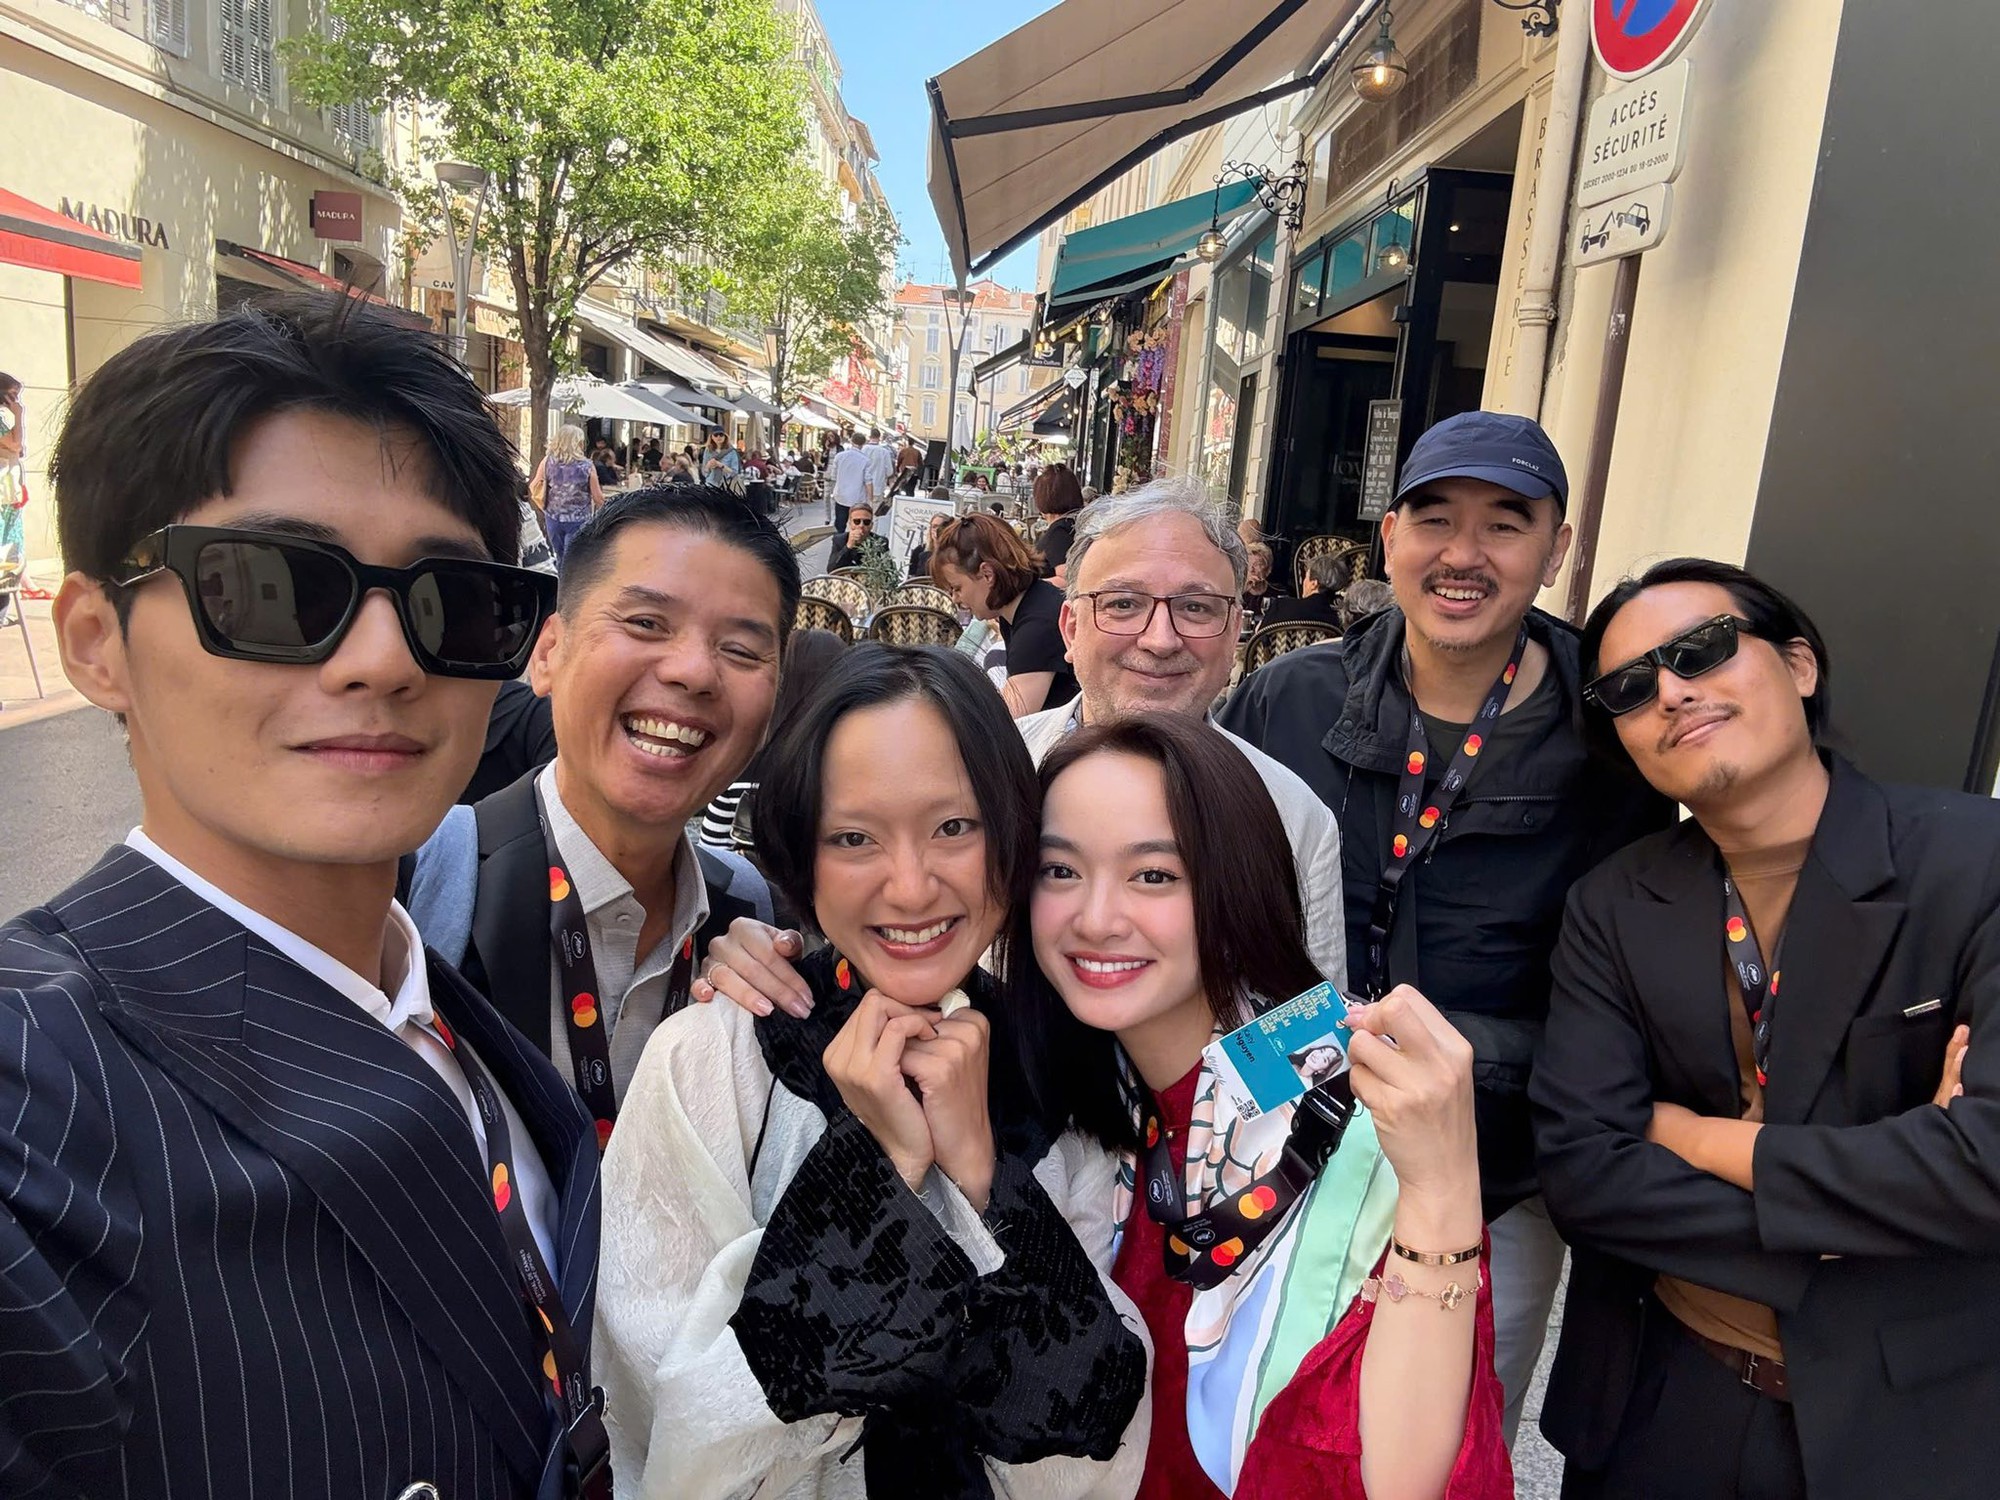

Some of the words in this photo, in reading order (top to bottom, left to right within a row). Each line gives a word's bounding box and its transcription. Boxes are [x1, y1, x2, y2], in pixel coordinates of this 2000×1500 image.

[1610, 90, 1657, 128] ACCÈS
[1593, 113, 1667, 164] SÉCURITÉ
[59, 196, 169, 249] MADURA
[317, 210, 355, 220] MADURA
[1505, 117, 1547, 377] BRASSERIE
[433, 279, 455, 289] CAV
[1512, 457, 1539, 471] FORCLAZ
[1302, 995, 1319, 1017] INTER
[1309, 992, 1321, 1007] VAL
[1315, 988, 1331, 1010] FESTI
[1271, 1012, 1281, 1024] DE
[1278, 1009, 1291, 1027] FILM
[1284, 1006, 1294, 1017] DU
[1290, 1002, 1301, 1018] NAL
[1297, 999, 1312, 1020] NATIO
[1257, 1020, 1271, 1035] NES
[1264, 1016, 1278, 1032] CAN
[1235, 1032, 1256, 1064] Nguyen
